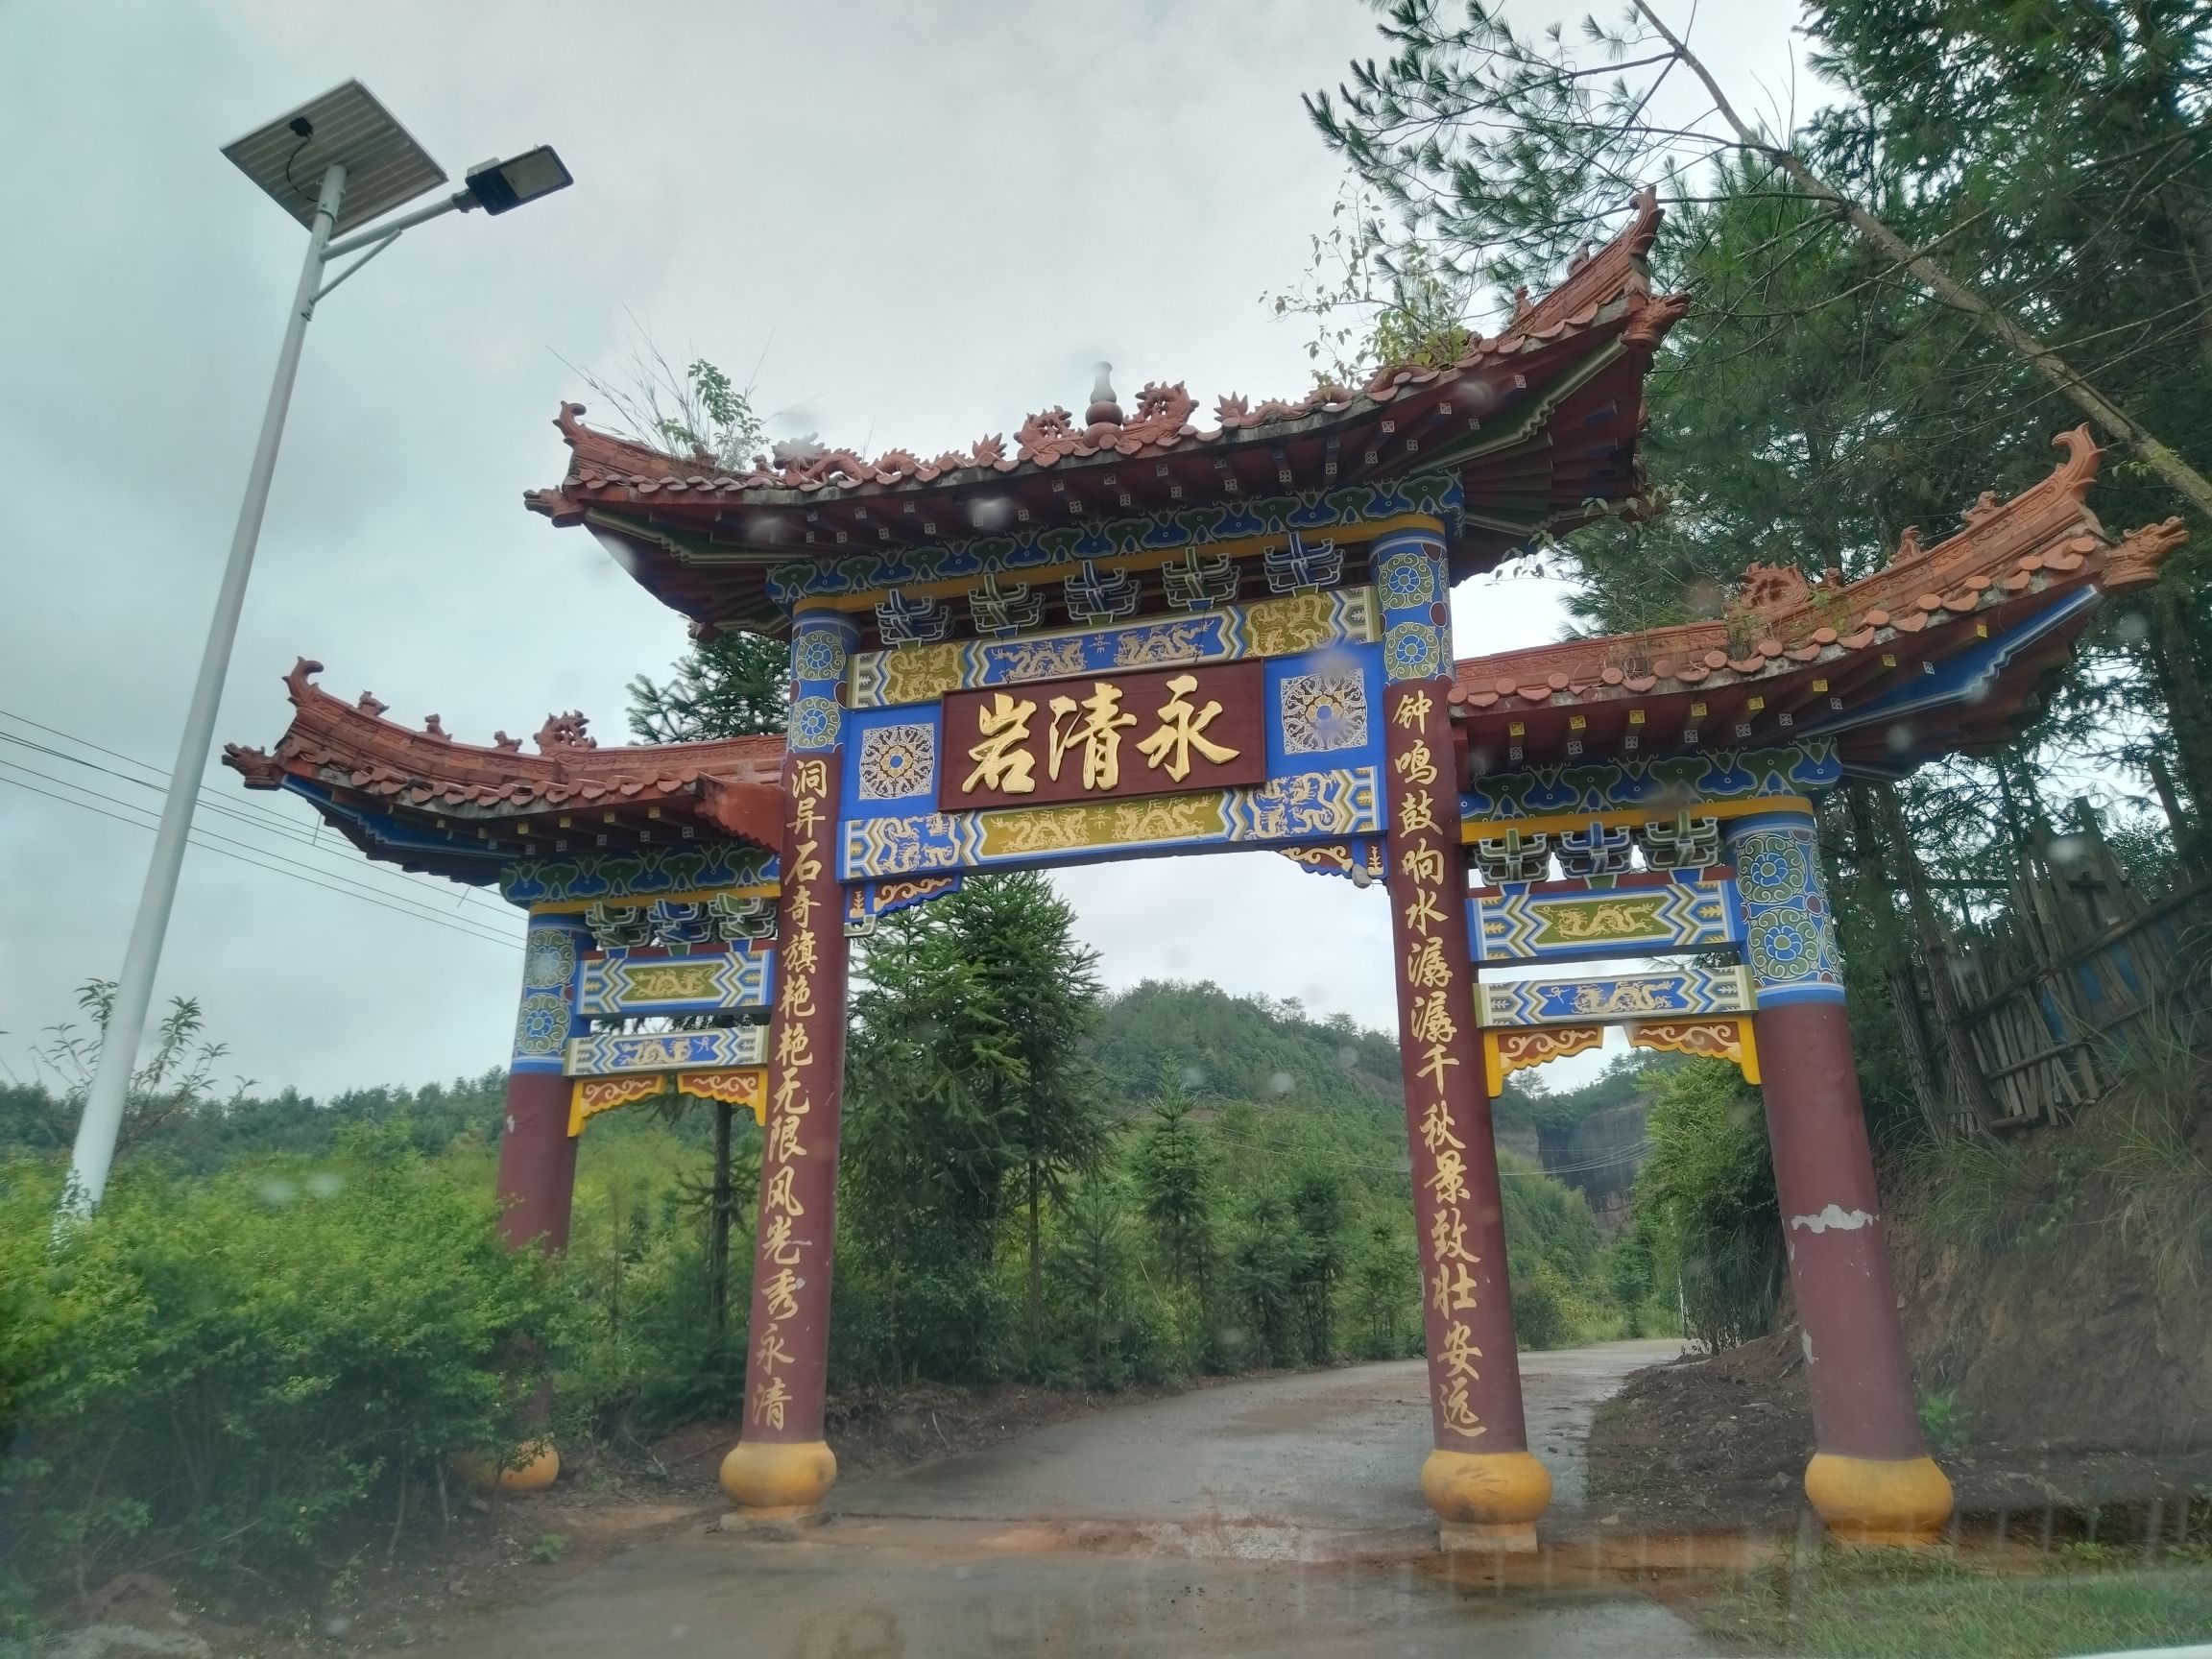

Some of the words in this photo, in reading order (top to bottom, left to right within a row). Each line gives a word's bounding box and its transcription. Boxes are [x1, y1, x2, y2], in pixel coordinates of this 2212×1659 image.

[962, 674, 1241, 794] 永清岩
[1392, 689, 1487, 1438] 钟鸣鼓响水潺潺千秋景致壮安远
